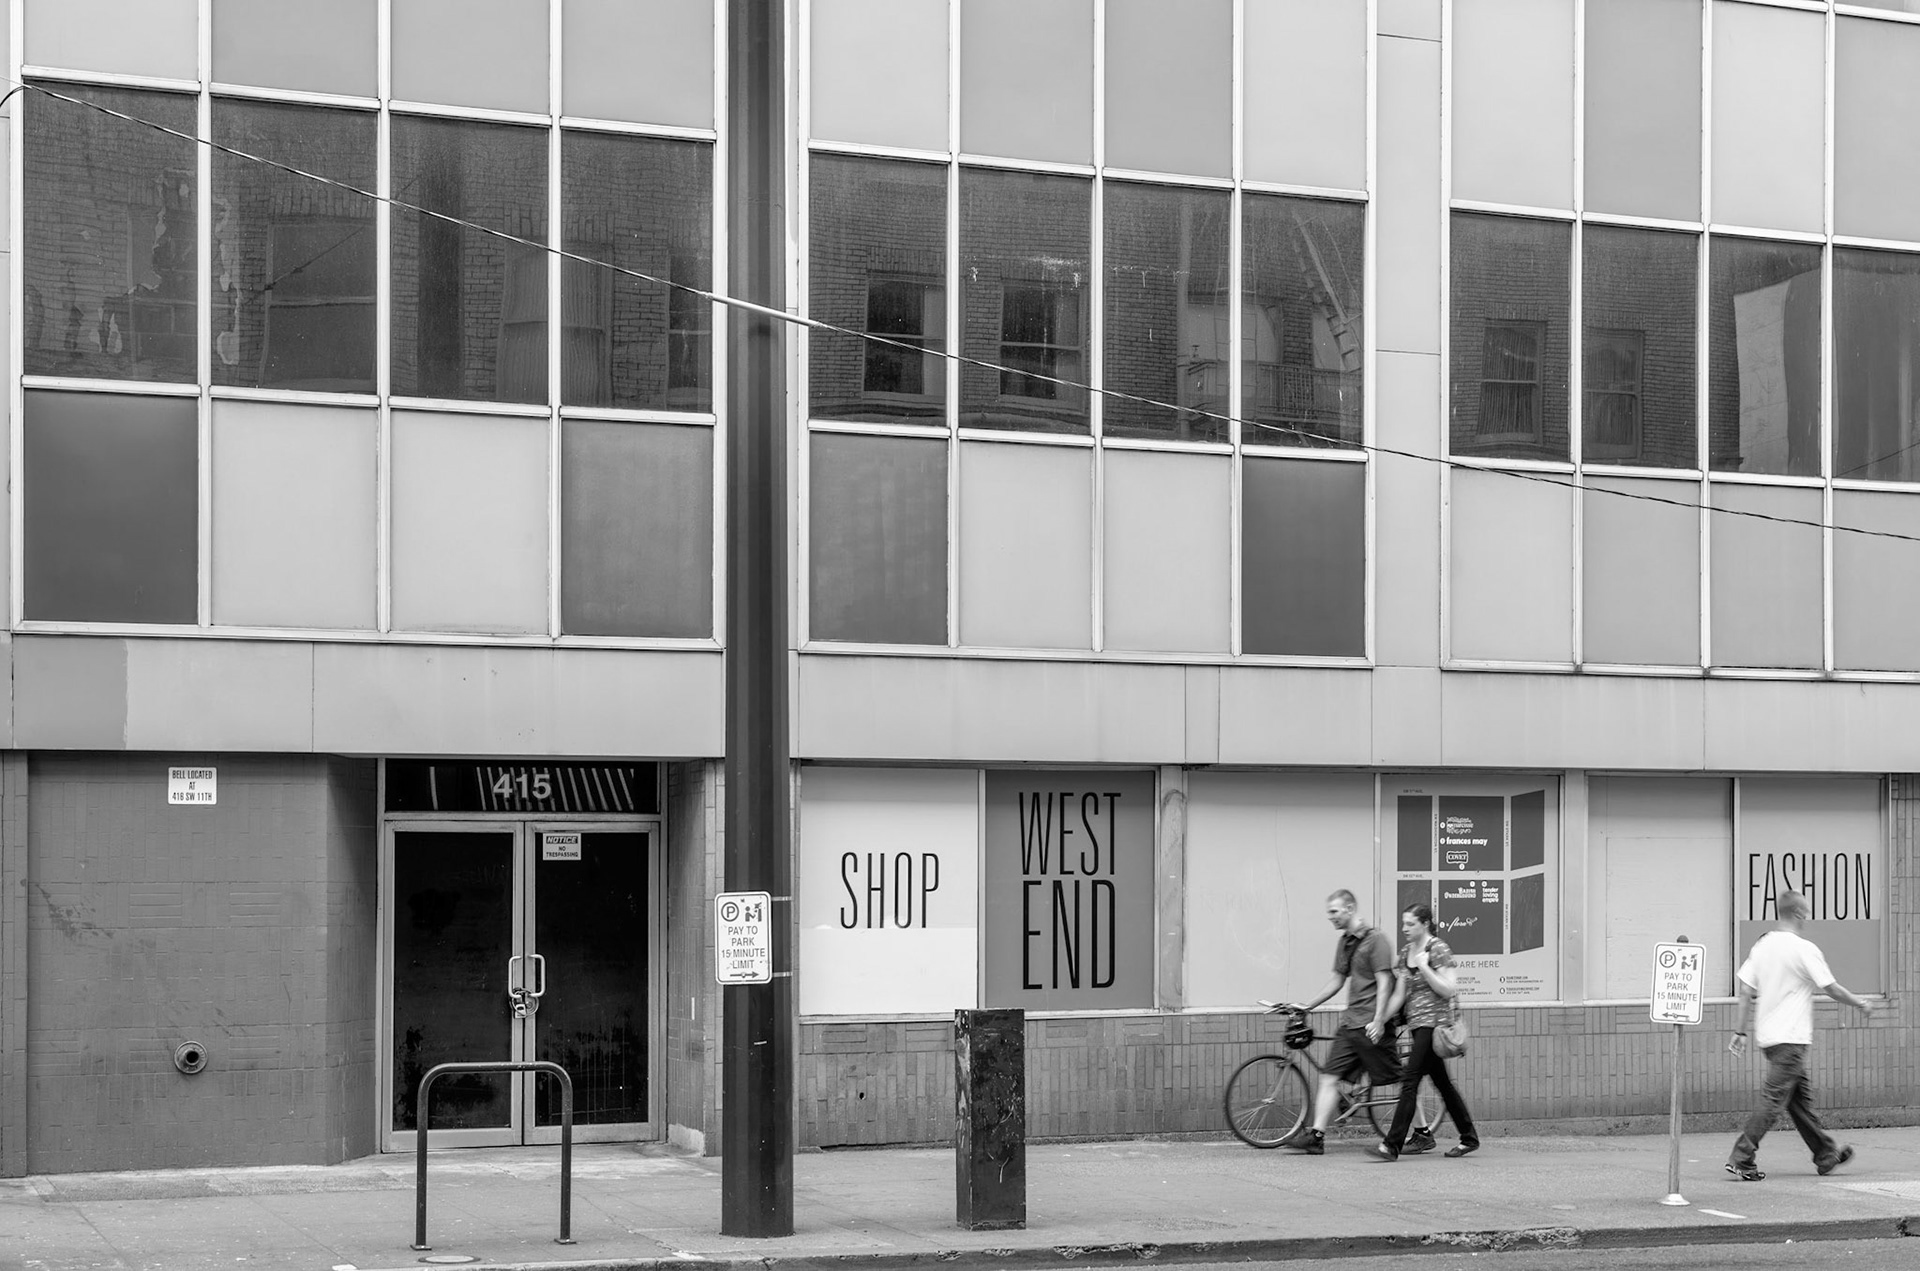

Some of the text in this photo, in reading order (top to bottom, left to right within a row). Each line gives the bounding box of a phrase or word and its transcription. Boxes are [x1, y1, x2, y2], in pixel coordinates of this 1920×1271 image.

[172, 770, 212, 779] BELL LOCATED
[189, 782, 196, 790] AT
[493, 773, 551, 799] 415
[172, 792, 212, 801] 416 SW 11TH
[1018, 792, 1121, 876] WEST
[546, 836, 578, 844] NOTICE
[1446, 836, 1471, 845] frances
[1472, 838, 1488, 846] may
[840, 852, 939, 928] SHOP
[1749, 853, 1871, 920] FASHION
[728, 926, 758, 935] PAY TO
[1022, 880, 1116, 989] END
[731, 937, 755, 946] PARK
[721, 948, 765, 958] 15 MINUTE
[732, 960, 754, 969] LIMIT
[1478, 960, 1499, 968] HERE
[1664, 972, 1692, 981] PAY TO
[1667, 982, 1688, 991] PARK
[1668, 992, 1697, 1001] MINUTE
[1666, 1002, 1686, 1011] LIMIT
